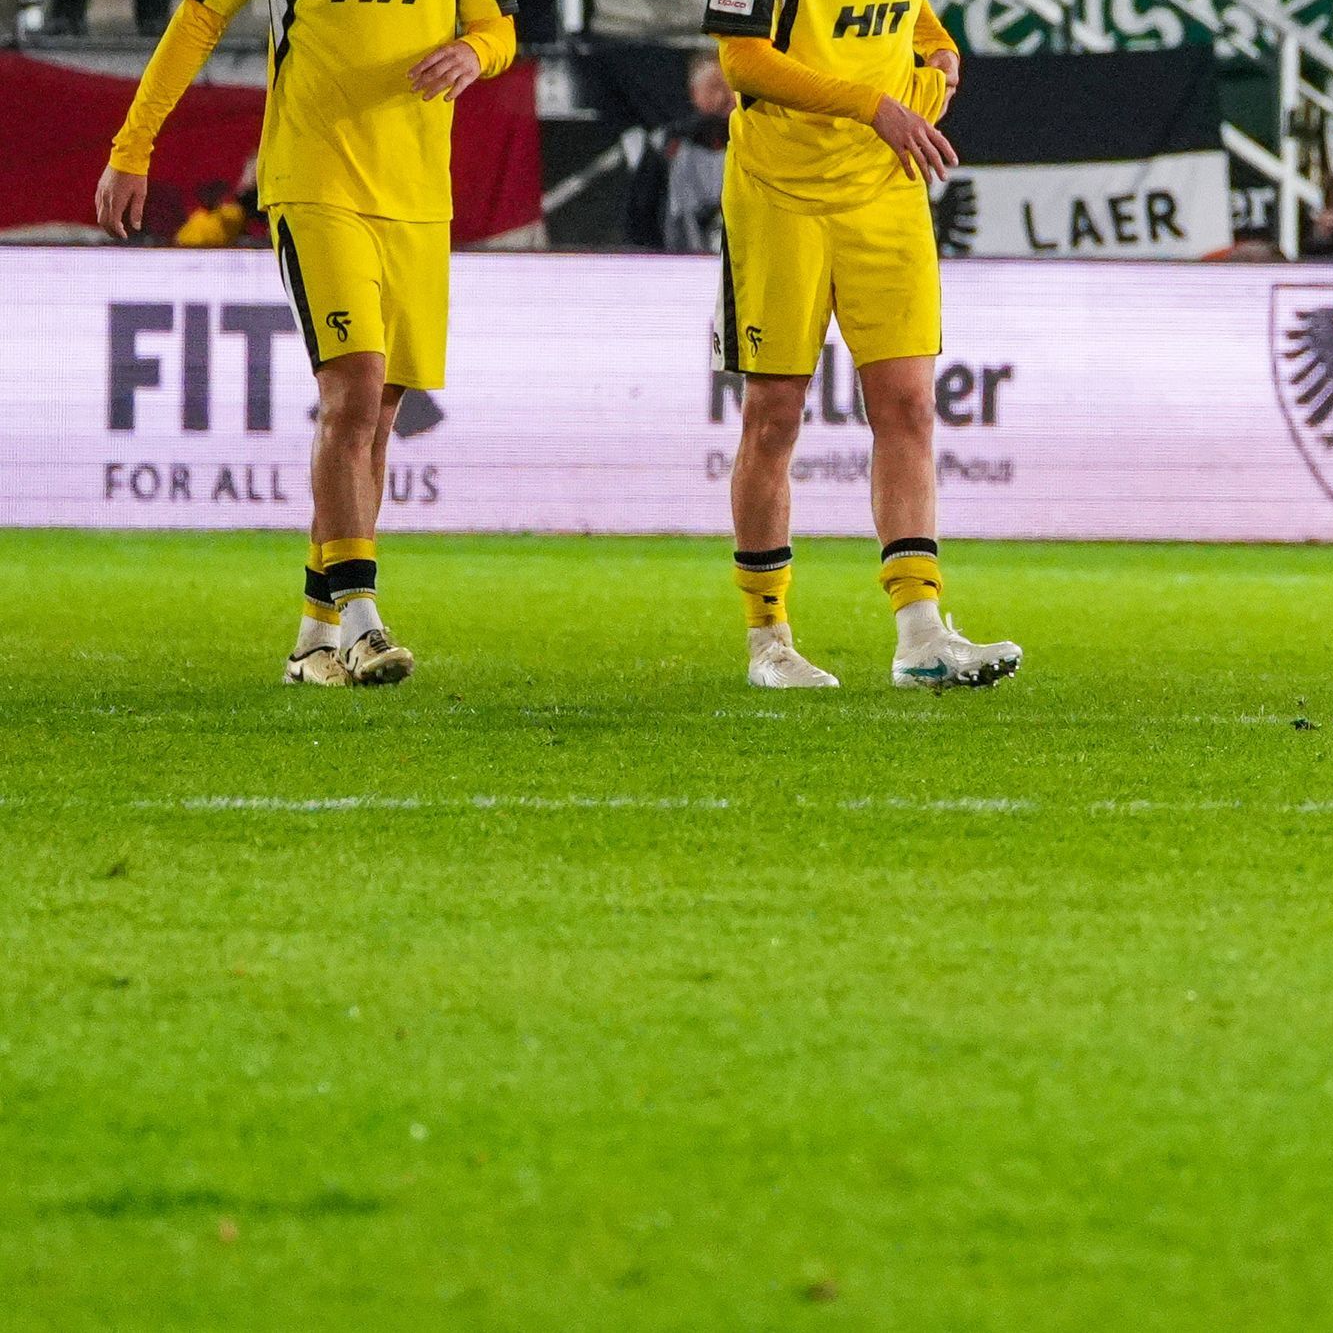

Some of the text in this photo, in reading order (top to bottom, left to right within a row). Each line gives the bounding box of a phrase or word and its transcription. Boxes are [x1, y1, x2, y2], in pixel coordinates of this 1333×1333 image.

[1022, 190, 1186, 251] LAER
[107, 304, 298, 431] FIT
[104, 463, 192, 502] FOR
[212, 464, 287, 502] ALL
